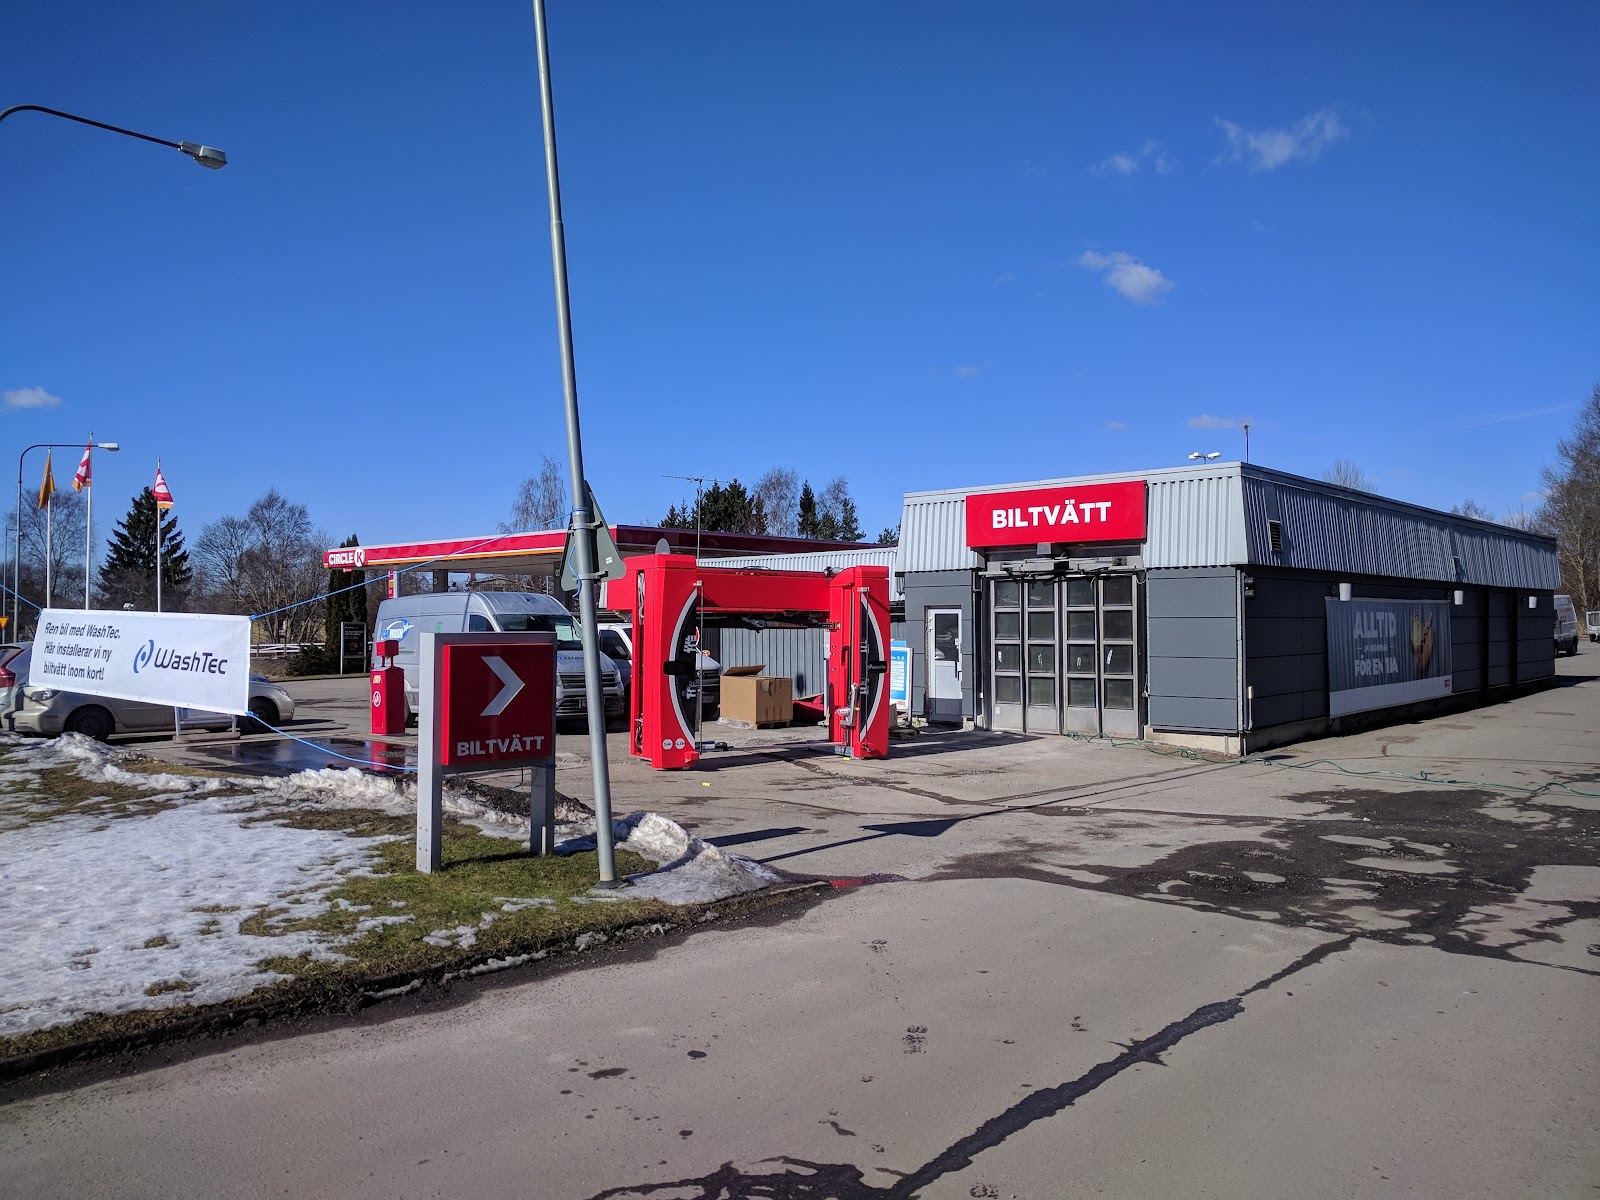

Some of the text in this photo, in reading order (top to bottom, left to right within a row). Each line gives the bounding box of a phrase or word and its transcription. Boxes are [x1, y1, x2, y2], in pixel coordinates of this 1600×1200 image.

[992, 499, 1112, 529] BILTVÄTT
[328, 549, 365, 566] CIRCLE K
[44, 622, 121, 639] Ren bil med WashTec.
[1353, 611, 1397, 638] ALLTID
[43, 641, 113, 663] Här installerar vi ny
[154, 648, 228, 675] WashTec
[43, 661, 105, 680] biltvätt inom kort!
[1355, 655, 1372, 677] FÖR
[1372, 658, 1384, 675] EN
[457, 734, 545, 757] BILTVÄTT
